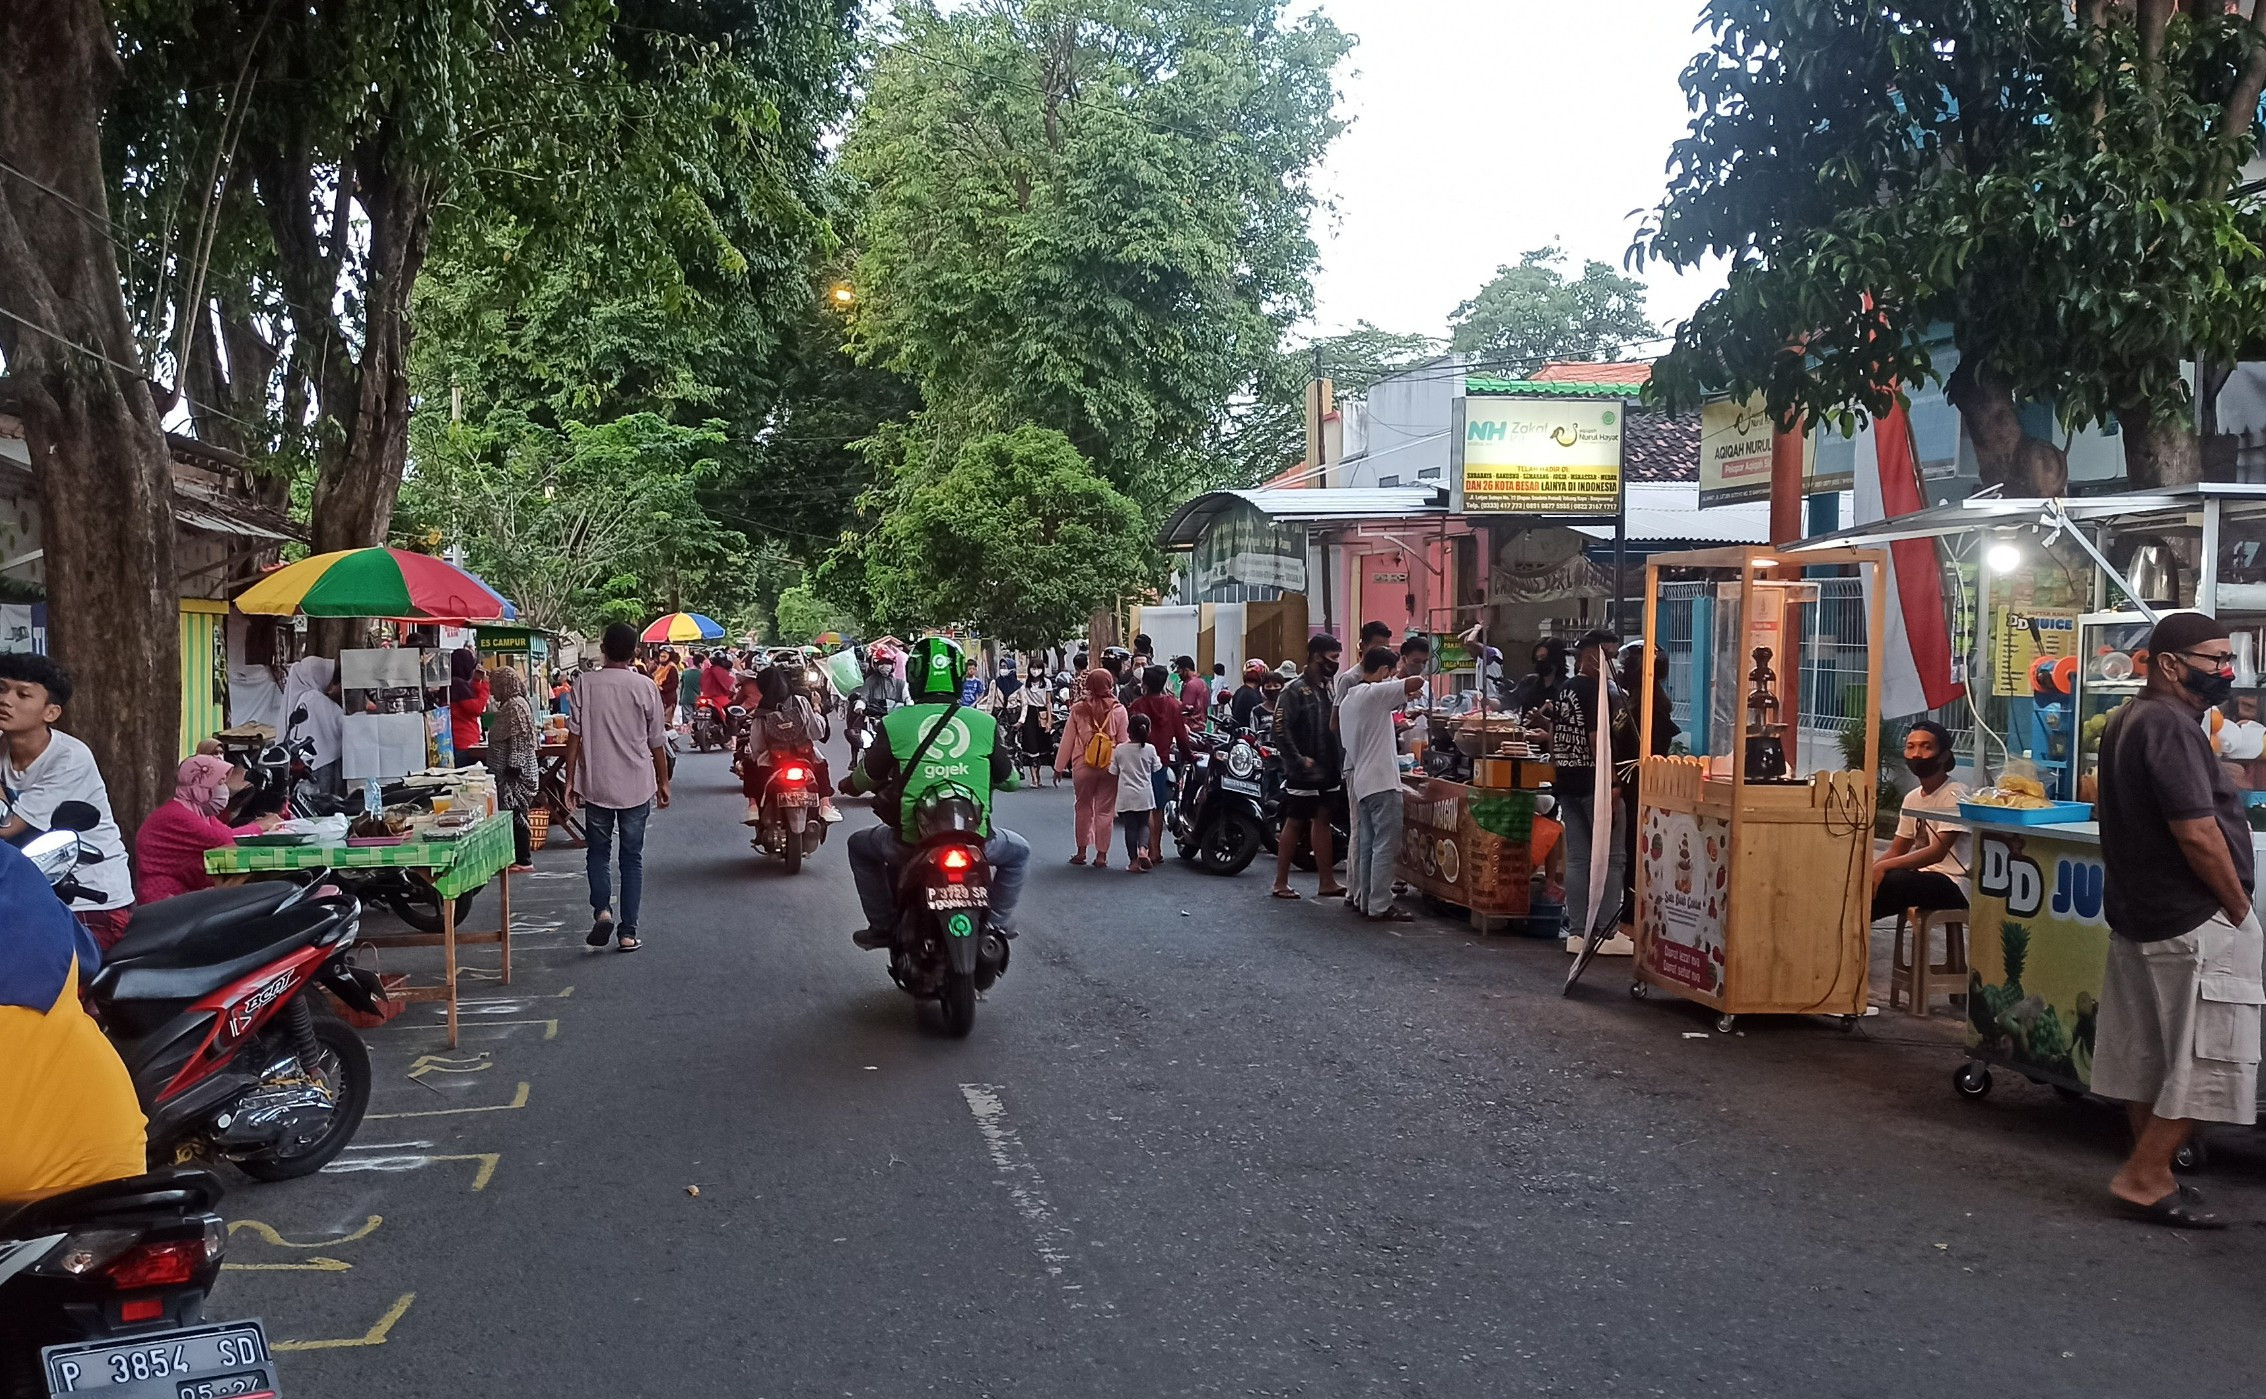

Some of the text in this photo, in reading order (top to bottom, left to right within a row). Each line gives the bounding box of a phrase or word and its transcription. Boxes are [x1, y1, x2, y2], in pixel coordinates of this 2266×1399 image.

[1467, 421, 1507, 441] NH
[1600, 434, 1619, 442] Hayat
[1714, 438, 1772, 460] AQIQAH NURUL
[1465, 480, 1617, 492] DAN 26 KOTA BESAR LAINYA DI INDONESIA
[480, 638, 526, 647] ES CAMPUR
[924, 761, 970, 779] gojek
[1981, 837, 2043, 915] DD
[61, 1337, 257, 1392] P 3854 SD
